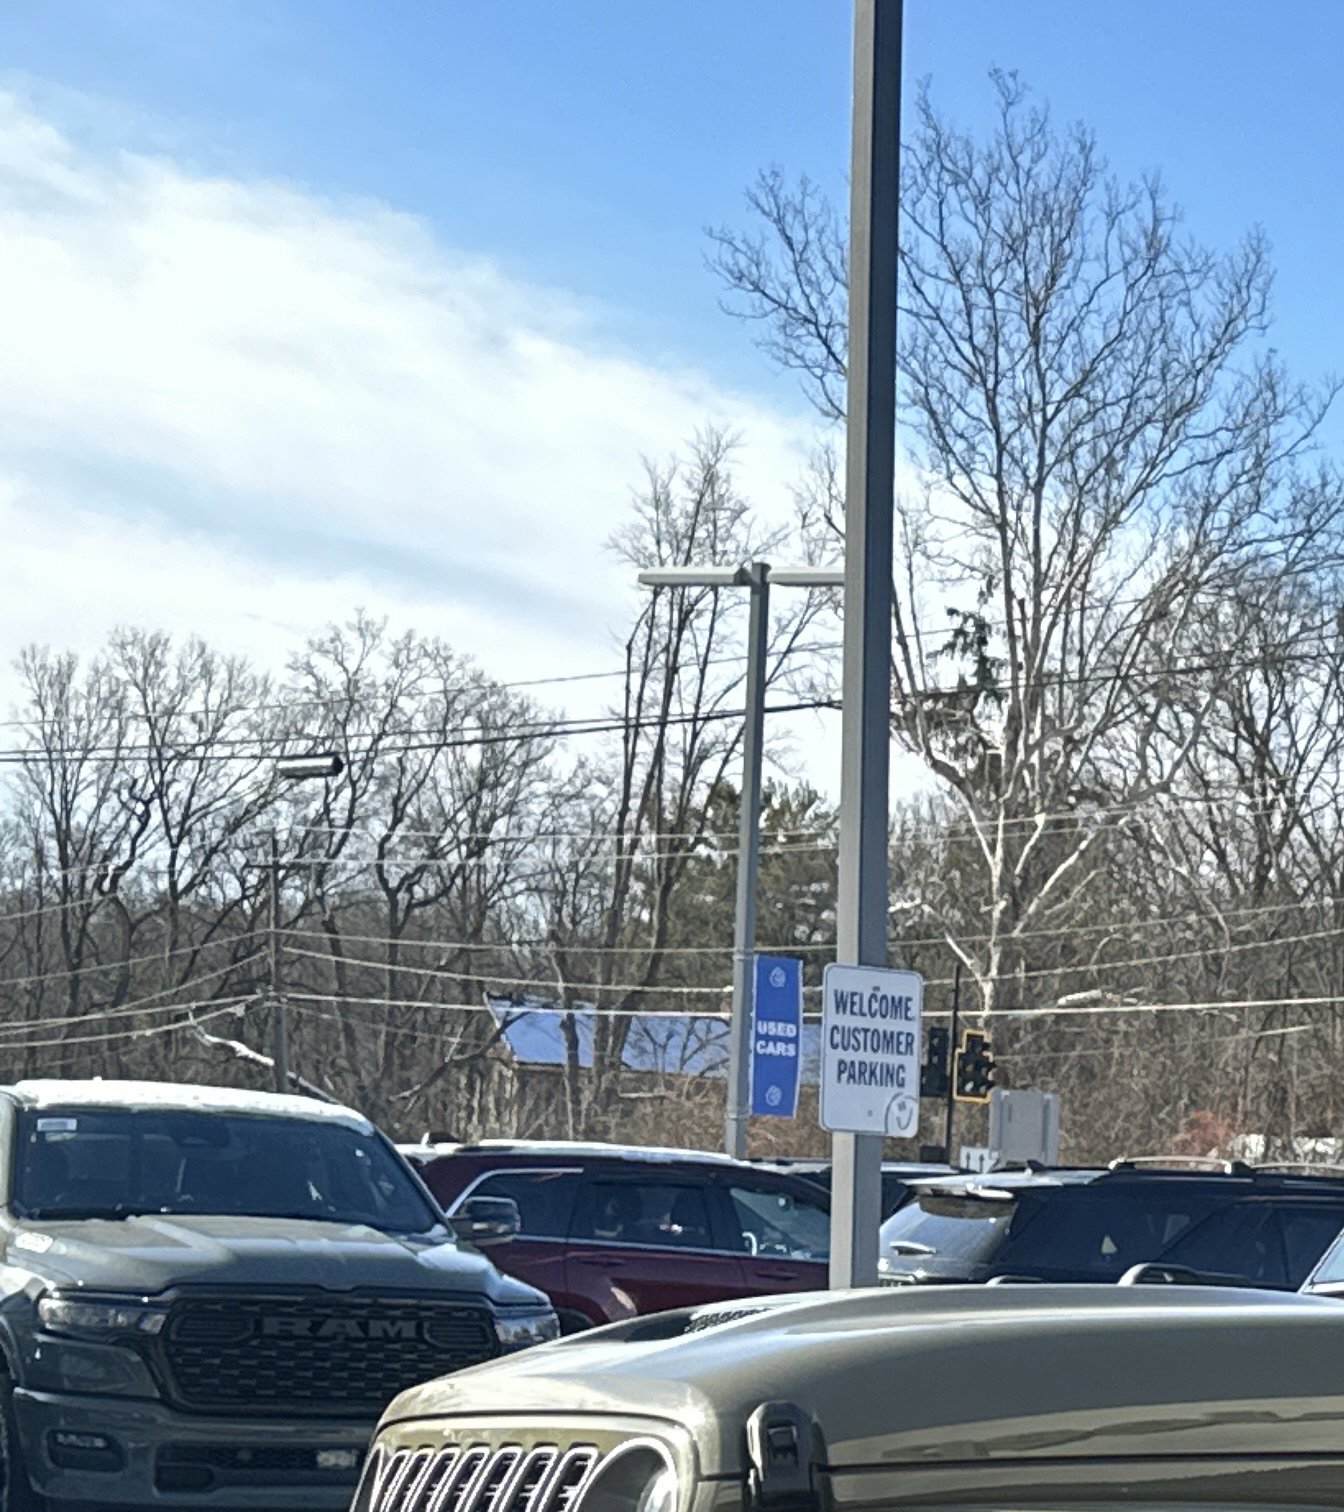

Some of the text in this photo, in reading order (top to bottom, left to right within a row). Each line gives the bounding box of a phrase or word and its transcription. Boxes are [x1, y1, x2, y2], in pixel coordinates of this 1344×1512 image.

[833, 989, 913, 1021] WELCOME
[757, 1020, 797, 1037] USED
[830, 1025, 915, 1056] CUSTOMER
[756, 1040, 796, 1056] CARS
[837, 1059, 906, 1088] PARKING
[262, 1316, 418, 1338] RAM
